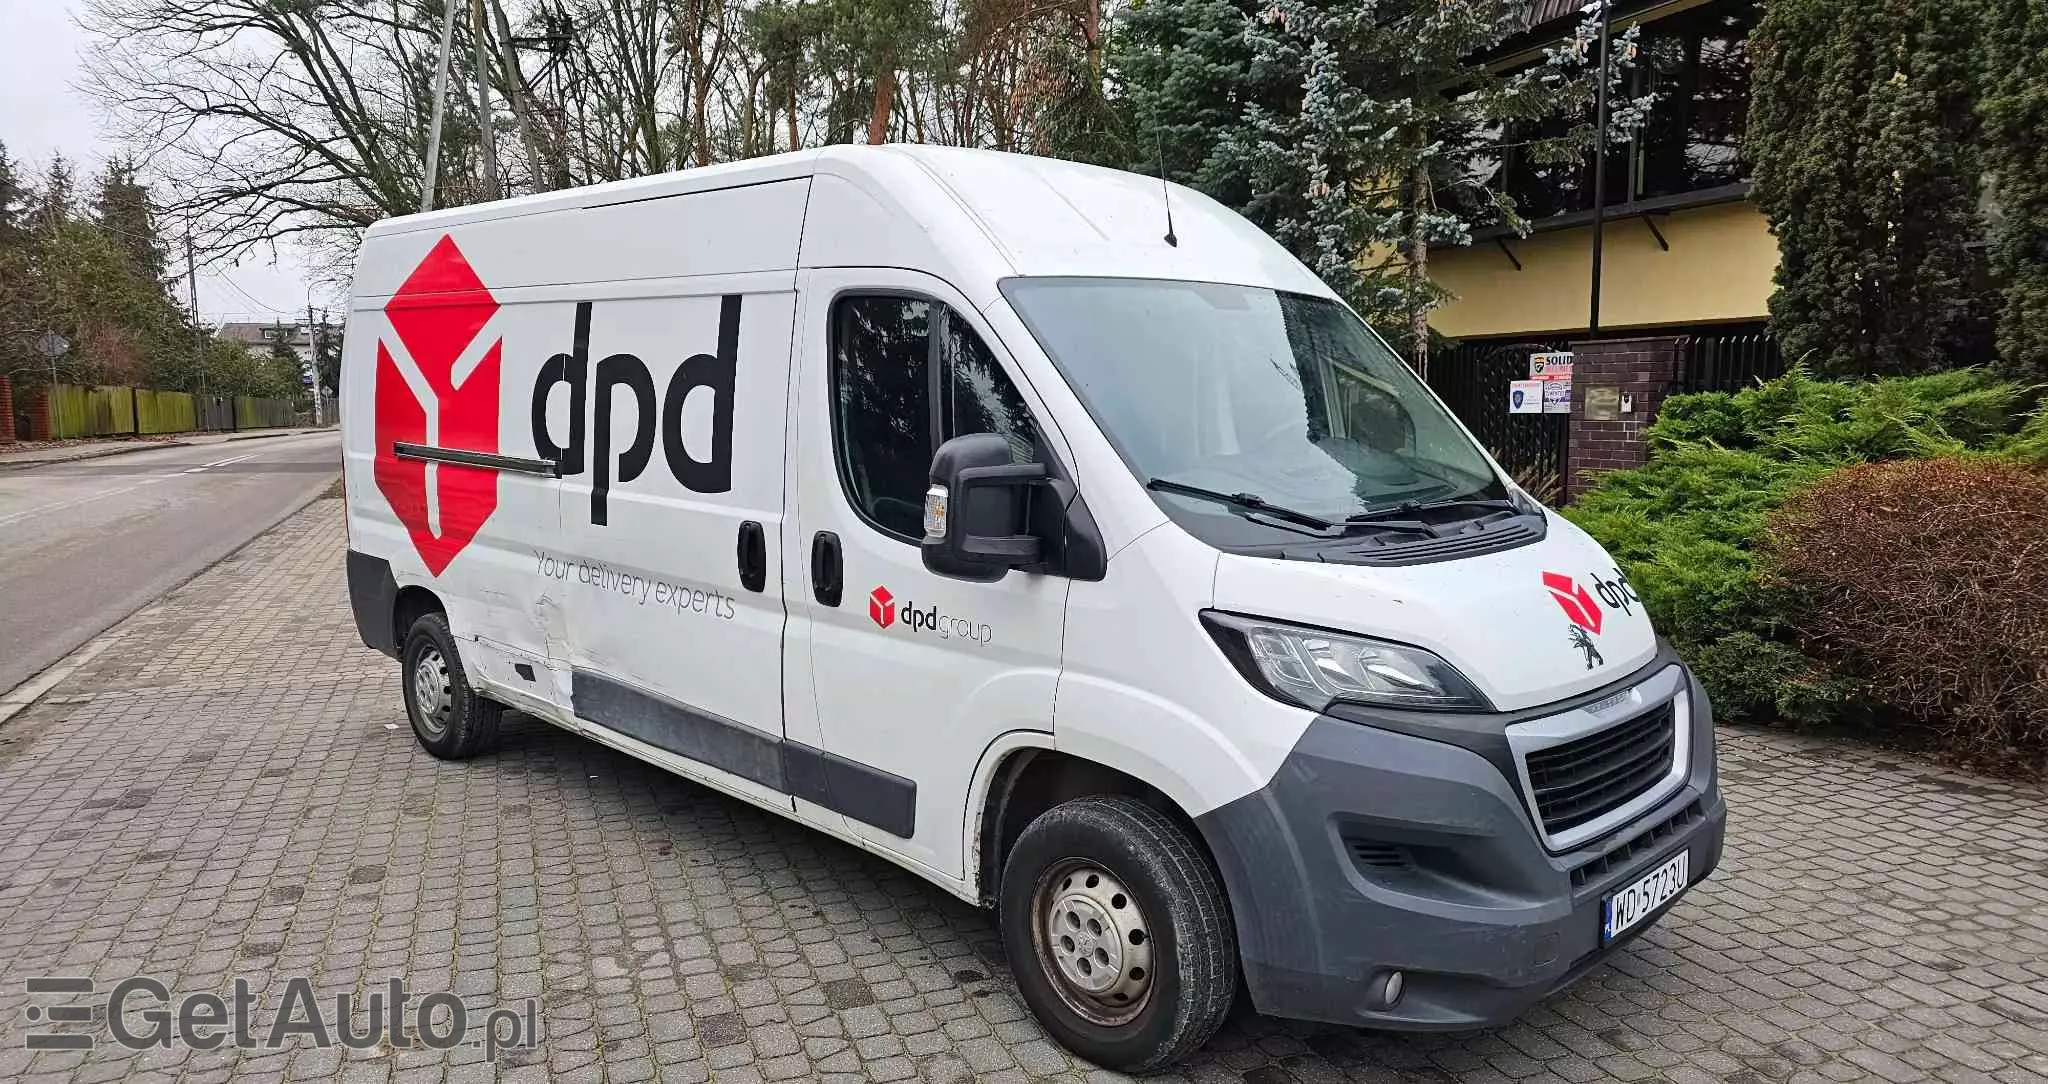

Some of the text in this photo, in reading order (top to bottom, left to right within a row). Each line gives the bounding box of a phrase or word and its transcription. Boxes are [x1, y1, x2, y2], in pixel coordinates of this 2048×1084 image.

[1546, 356, 1573, 366] SOLID
[532, 294, 743, 526] dpd
[534, 550, 736, 620] Your delivery experts
